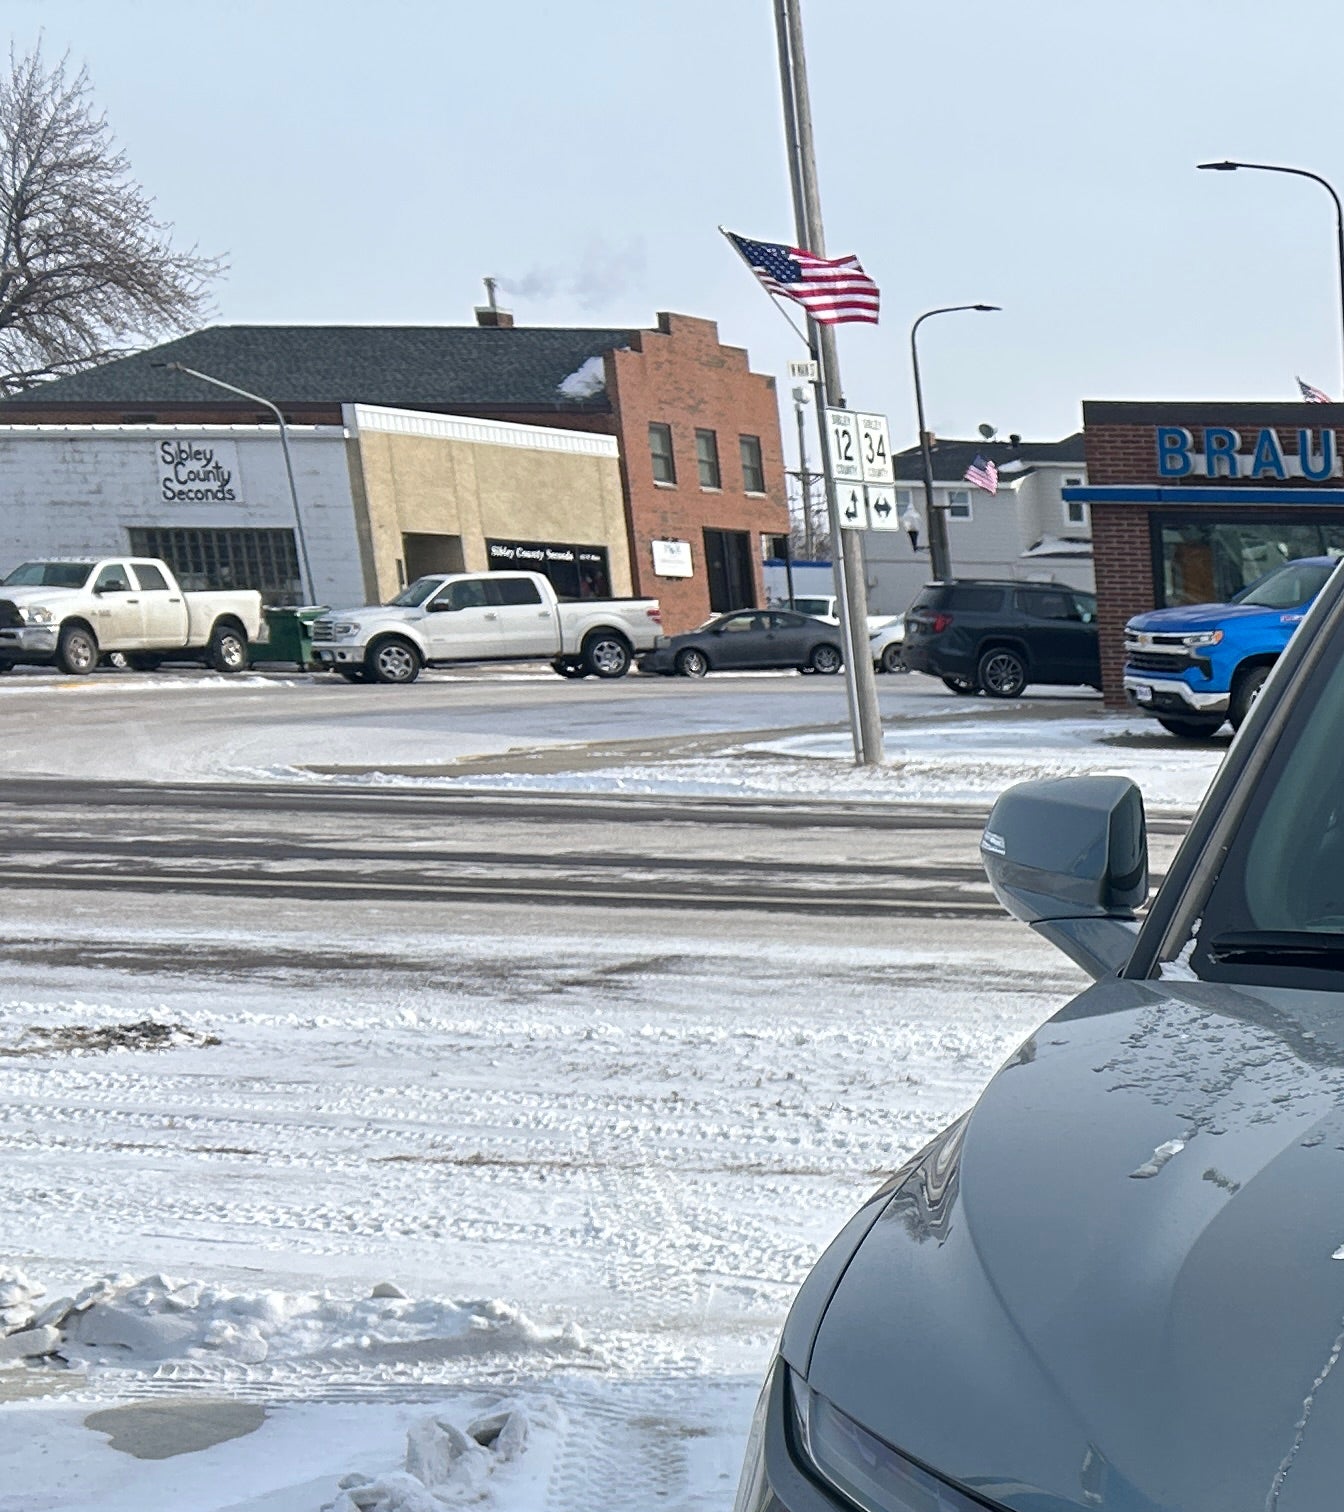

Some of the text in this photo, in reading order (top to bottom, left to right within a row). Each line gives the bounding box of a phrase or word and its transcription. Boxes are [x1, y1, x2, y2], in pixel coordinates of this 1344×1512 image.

[161, 441, 213, 468] Sibley
[835, 428, 854, 460] 12
[865, 432, 886, 464] 34
[1156, 426, 1336, 481] BRAU
[174, 460, 231, 487] County
[163, 477, 236, 501] Seconds
